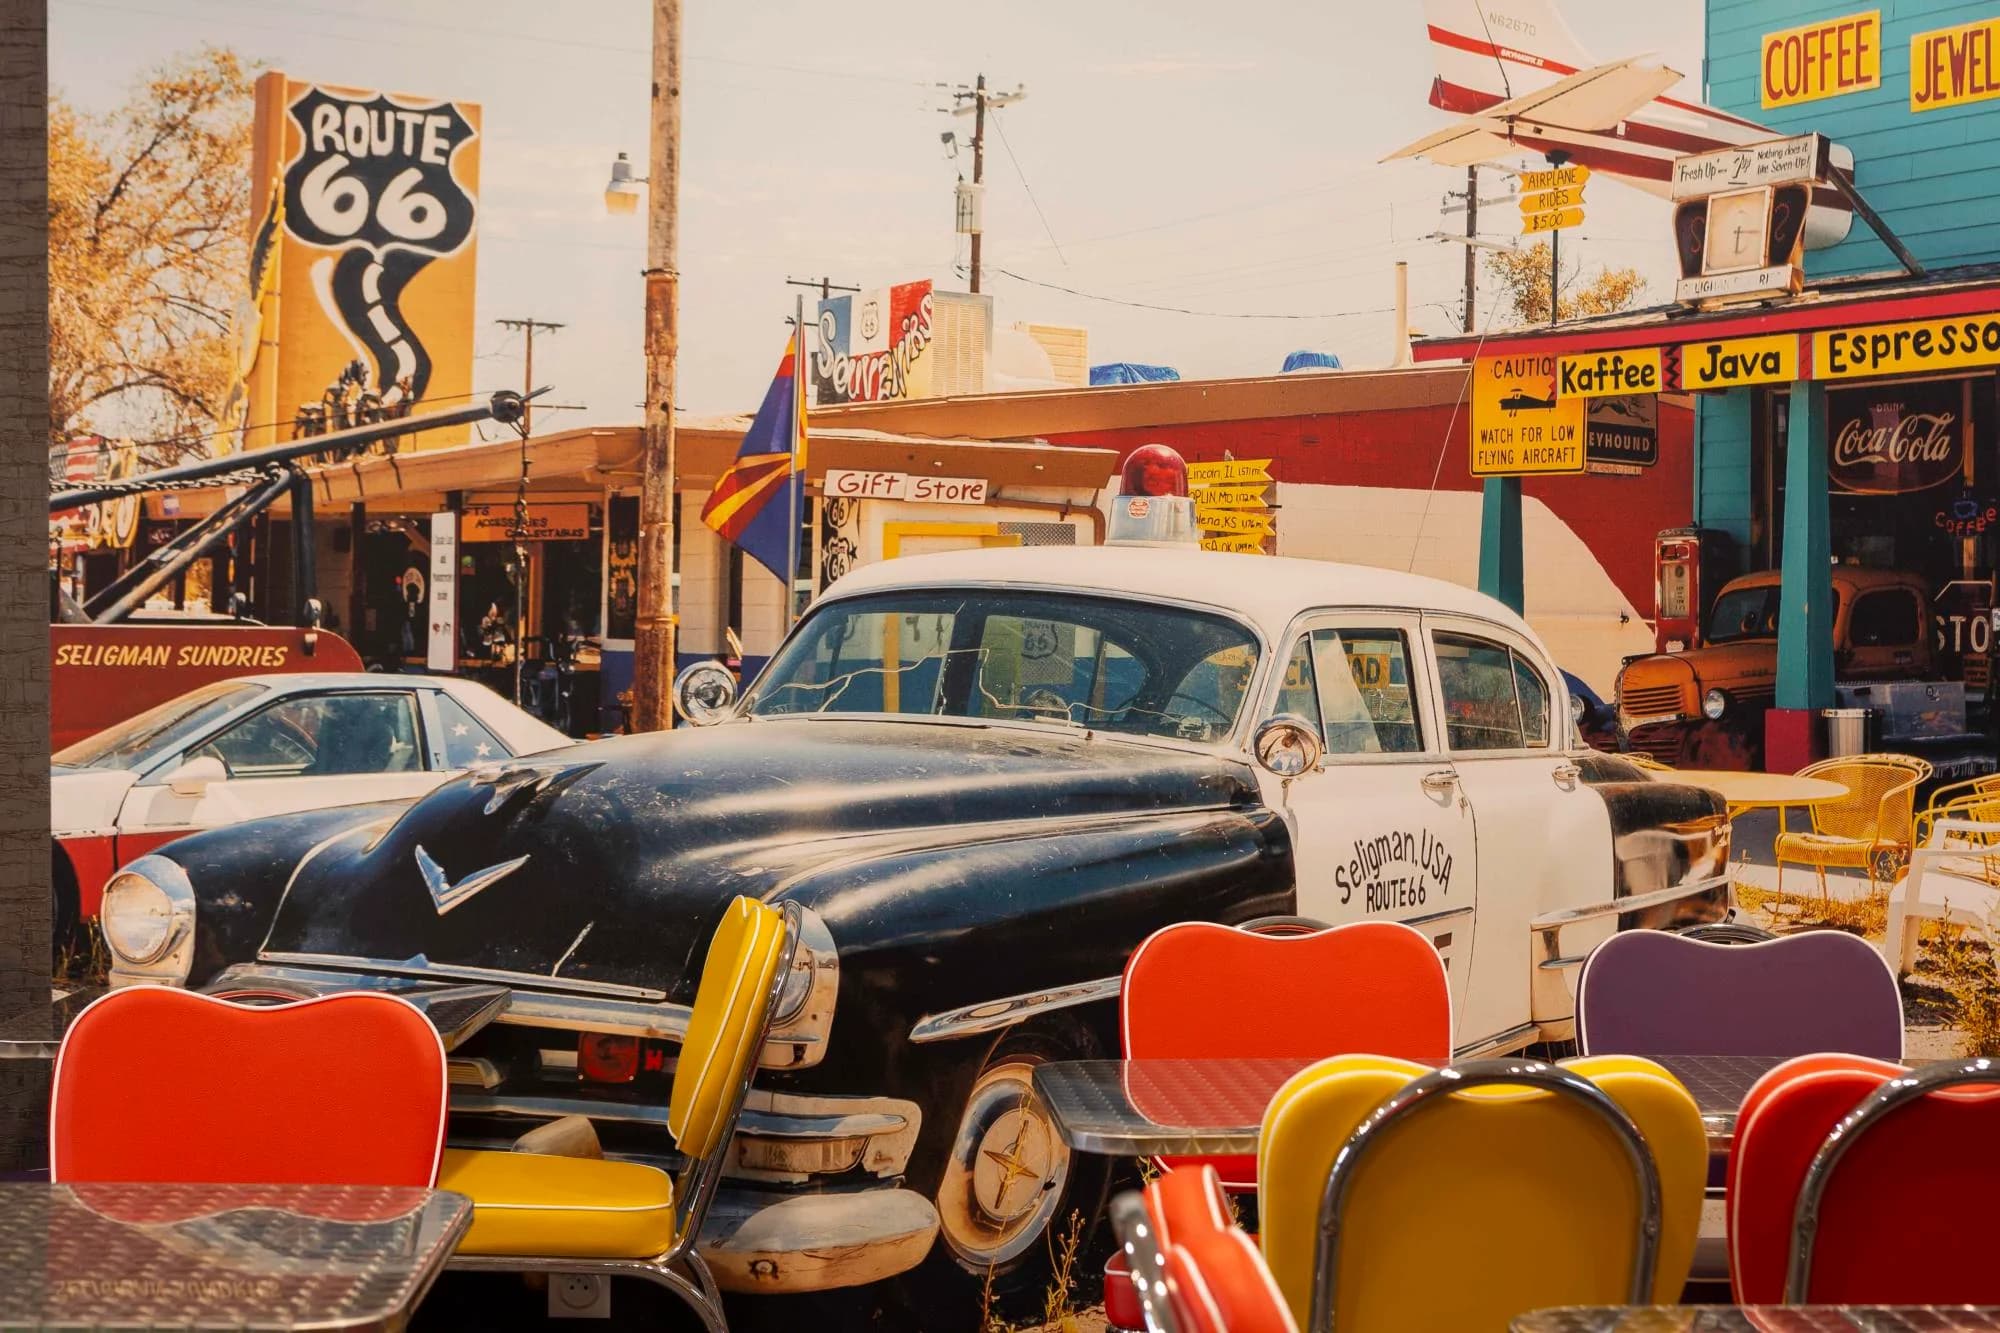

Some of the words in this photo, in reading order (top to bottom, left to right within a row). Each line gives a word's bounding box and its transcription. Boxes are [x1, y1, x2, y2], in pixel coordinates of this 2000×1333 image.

[1765, 19, 1873, 101] COFFEE
[312, 103, 451, 166] ROUTE
[1528, 168, 1577, 188] AIRPLANE
[300, 153, 448, 241] 66
[1539, 190, 1568, 208] RIDES
[1829, 320, 2000, 373] Espresso
[1494, 357, 1551, 379] CAUTIO
[1561, 355, 1655, 394] Kaffee
[1700, 346, 1781, 381] Java
[1480, 428, 1513, 444] WATCH
[1521, 425, 1542, 442] FOR
[1551, 425, 1575, 441] LOW
[1588, 431, 1650, 452] EYHOUND
[1478, 450, 1514, 466] FLYING
[1522, 447, 1576, 465] AIRCRAFT
[838, 473, 899, 495] Gift
[915, 478, 983, 500] Store
[832, 502, 845, 521] 66
[832, 558, 845, 577] 66
[1936, 615, 1989, 653] STO
[56, 645, 171, 666] SELIGMAN
[177, 646, 289, 667] SUNDRIES
[1421, 828, 1453, 896] USA
